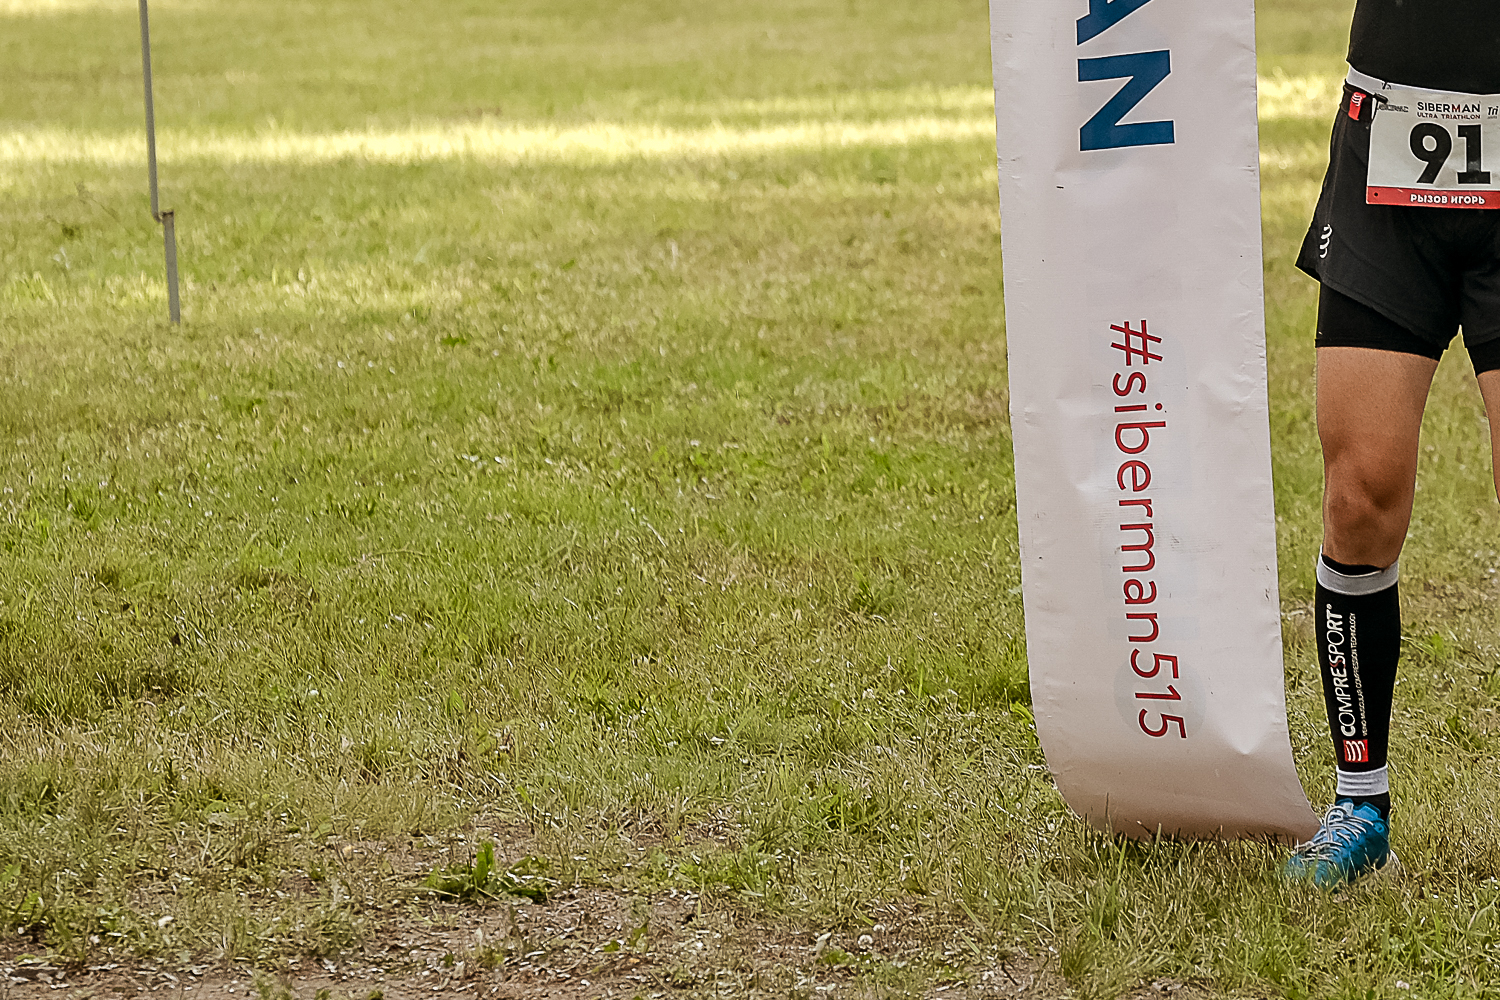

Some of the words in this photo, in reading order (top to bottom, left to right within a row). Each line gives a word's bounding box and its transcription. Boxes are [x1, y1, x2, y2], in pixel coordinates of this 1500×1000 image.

[1417, 101, 1481, 113] SIBERMAN
[1409, 123, 1491, 185] 91
[1410, 194, 1448, 204] РЫЗОВ
[1451, 195, 1486, 205] ИГОРЬ
[1109, 319, 1187, 740] #siberman515
